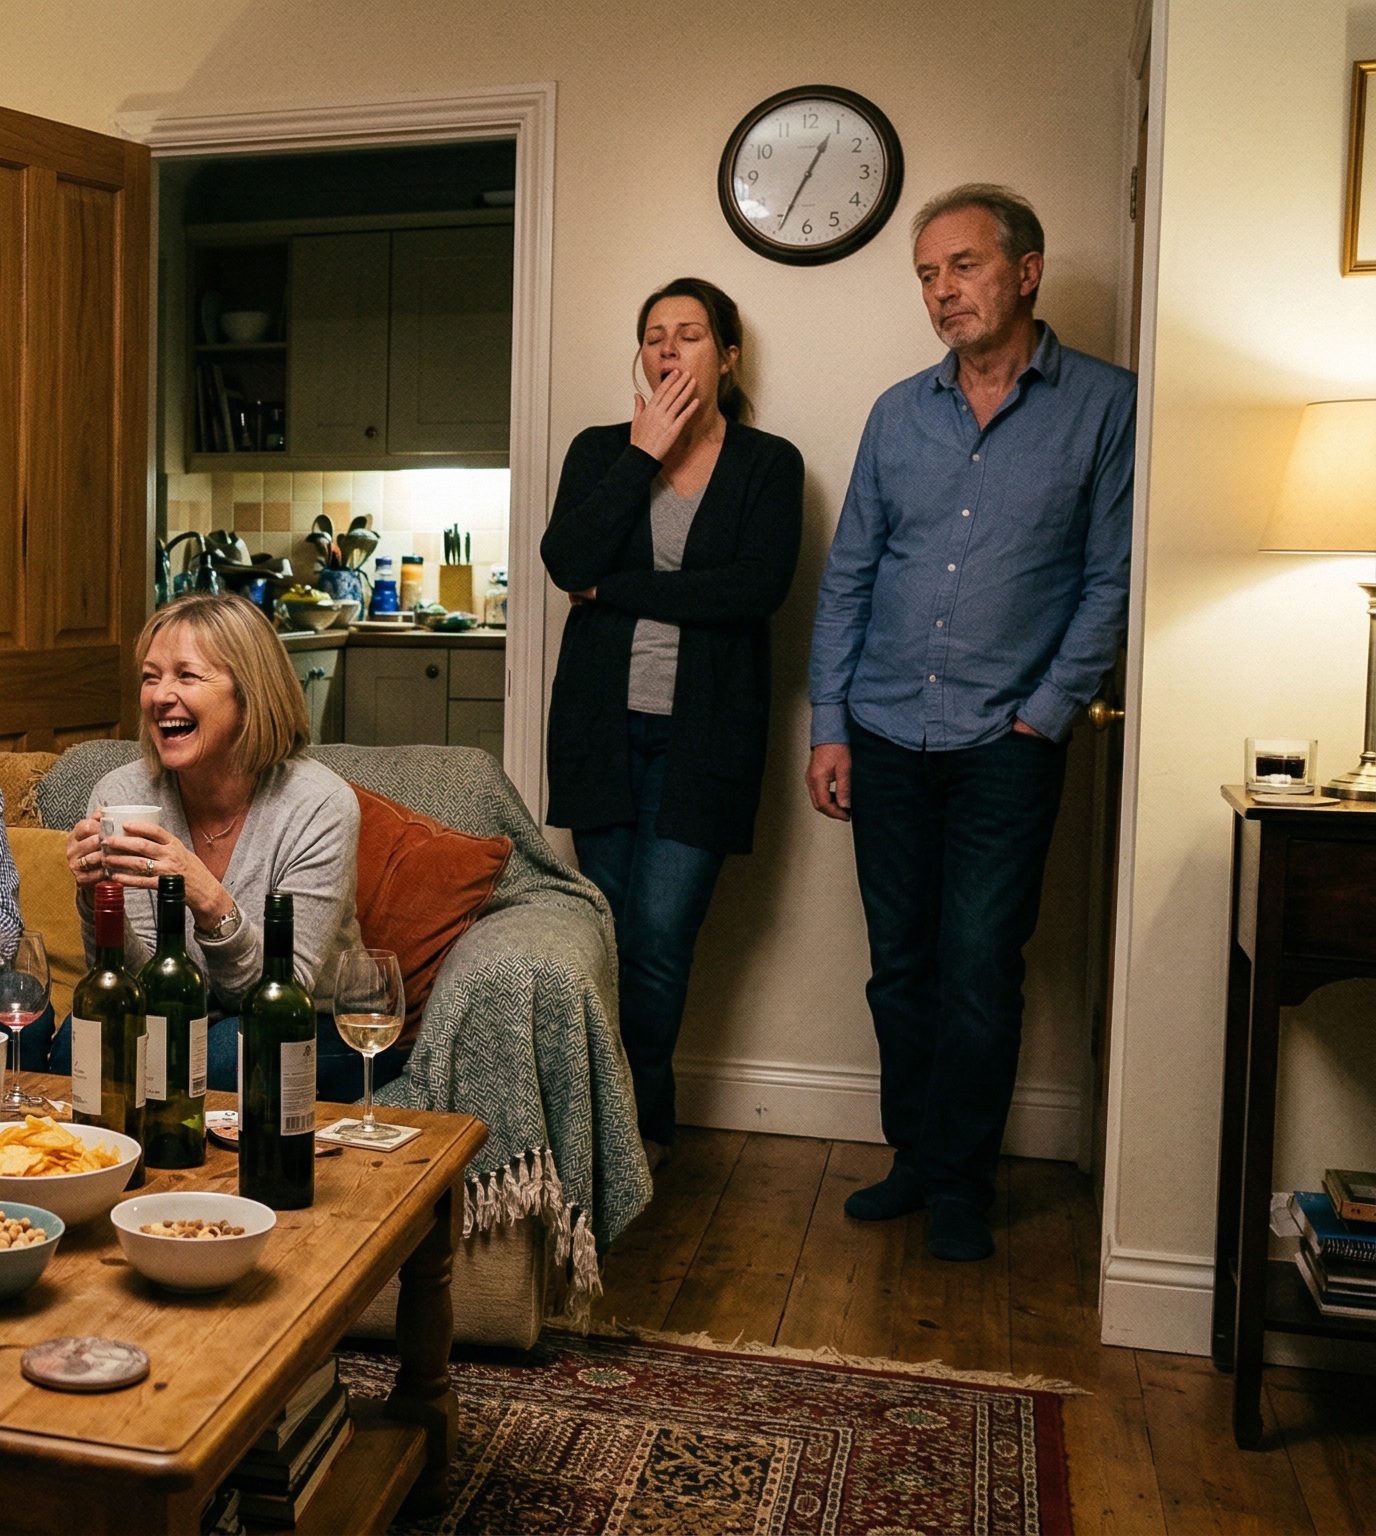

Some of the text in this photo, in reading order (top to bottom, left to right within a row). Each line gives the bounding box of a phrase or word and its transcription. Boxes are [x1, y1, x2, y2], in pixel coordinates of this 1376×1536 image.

[802, 113, 819, 129] 12
[836, 119, 841, 135] 1
[778, 122, 790, 138] 11
[756, 144, 773, 160] 10
[851, 137, 863, 153] 2
[747, 170, 759, 186] 9
[859, 164, 870, 180] 3
[848, 191, 862, 207] 4
[801, 218, 813, 235] 6
[828, 211, 840, 227] 5
